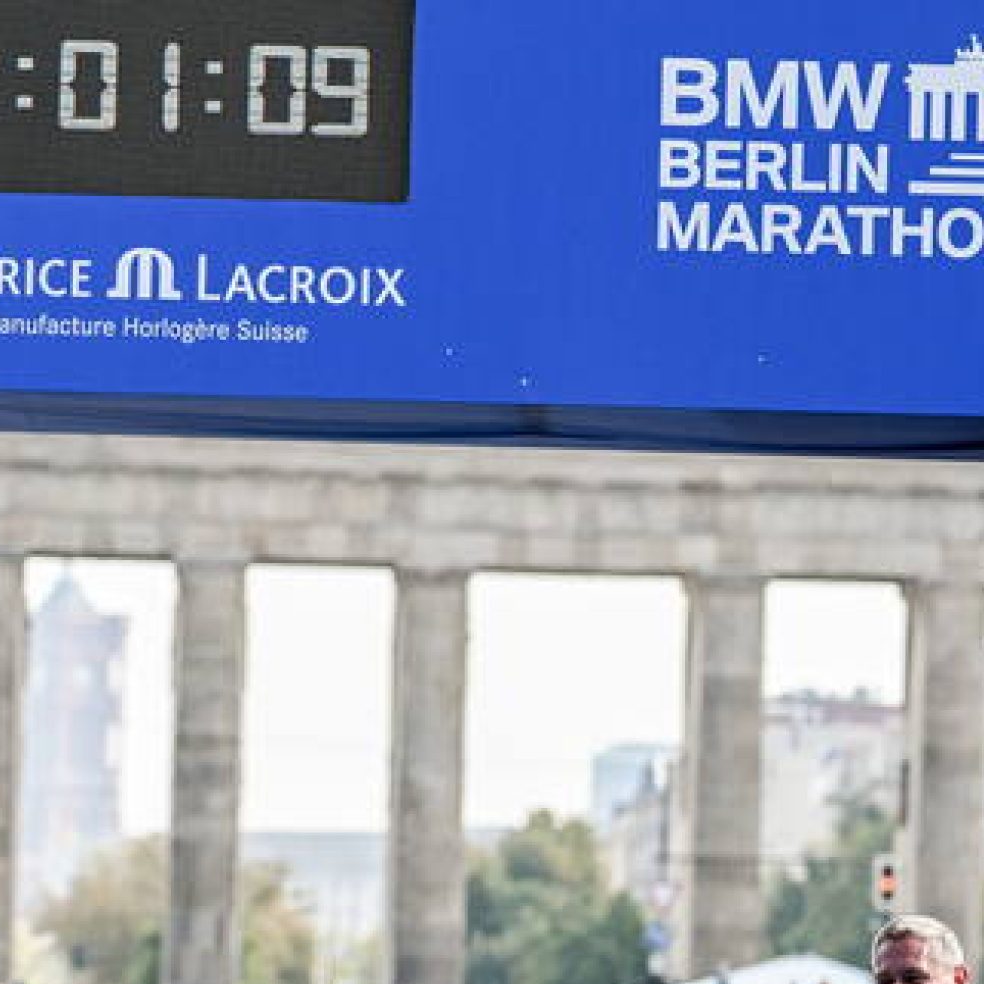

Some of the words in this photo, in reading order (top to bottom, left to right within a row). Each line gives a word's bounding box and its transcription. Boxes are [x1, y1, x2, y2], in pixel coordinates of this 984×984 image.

[660, 57, 892, 133] BMW
[659, 140, 889, 195] BERLIN
[657, 202, 984, 258] MARATHO
[197, 254, 406, 307] LACROIX
[123, 317, 230, 344] Horlogère
[237, 321, 308, 344] Suisse
